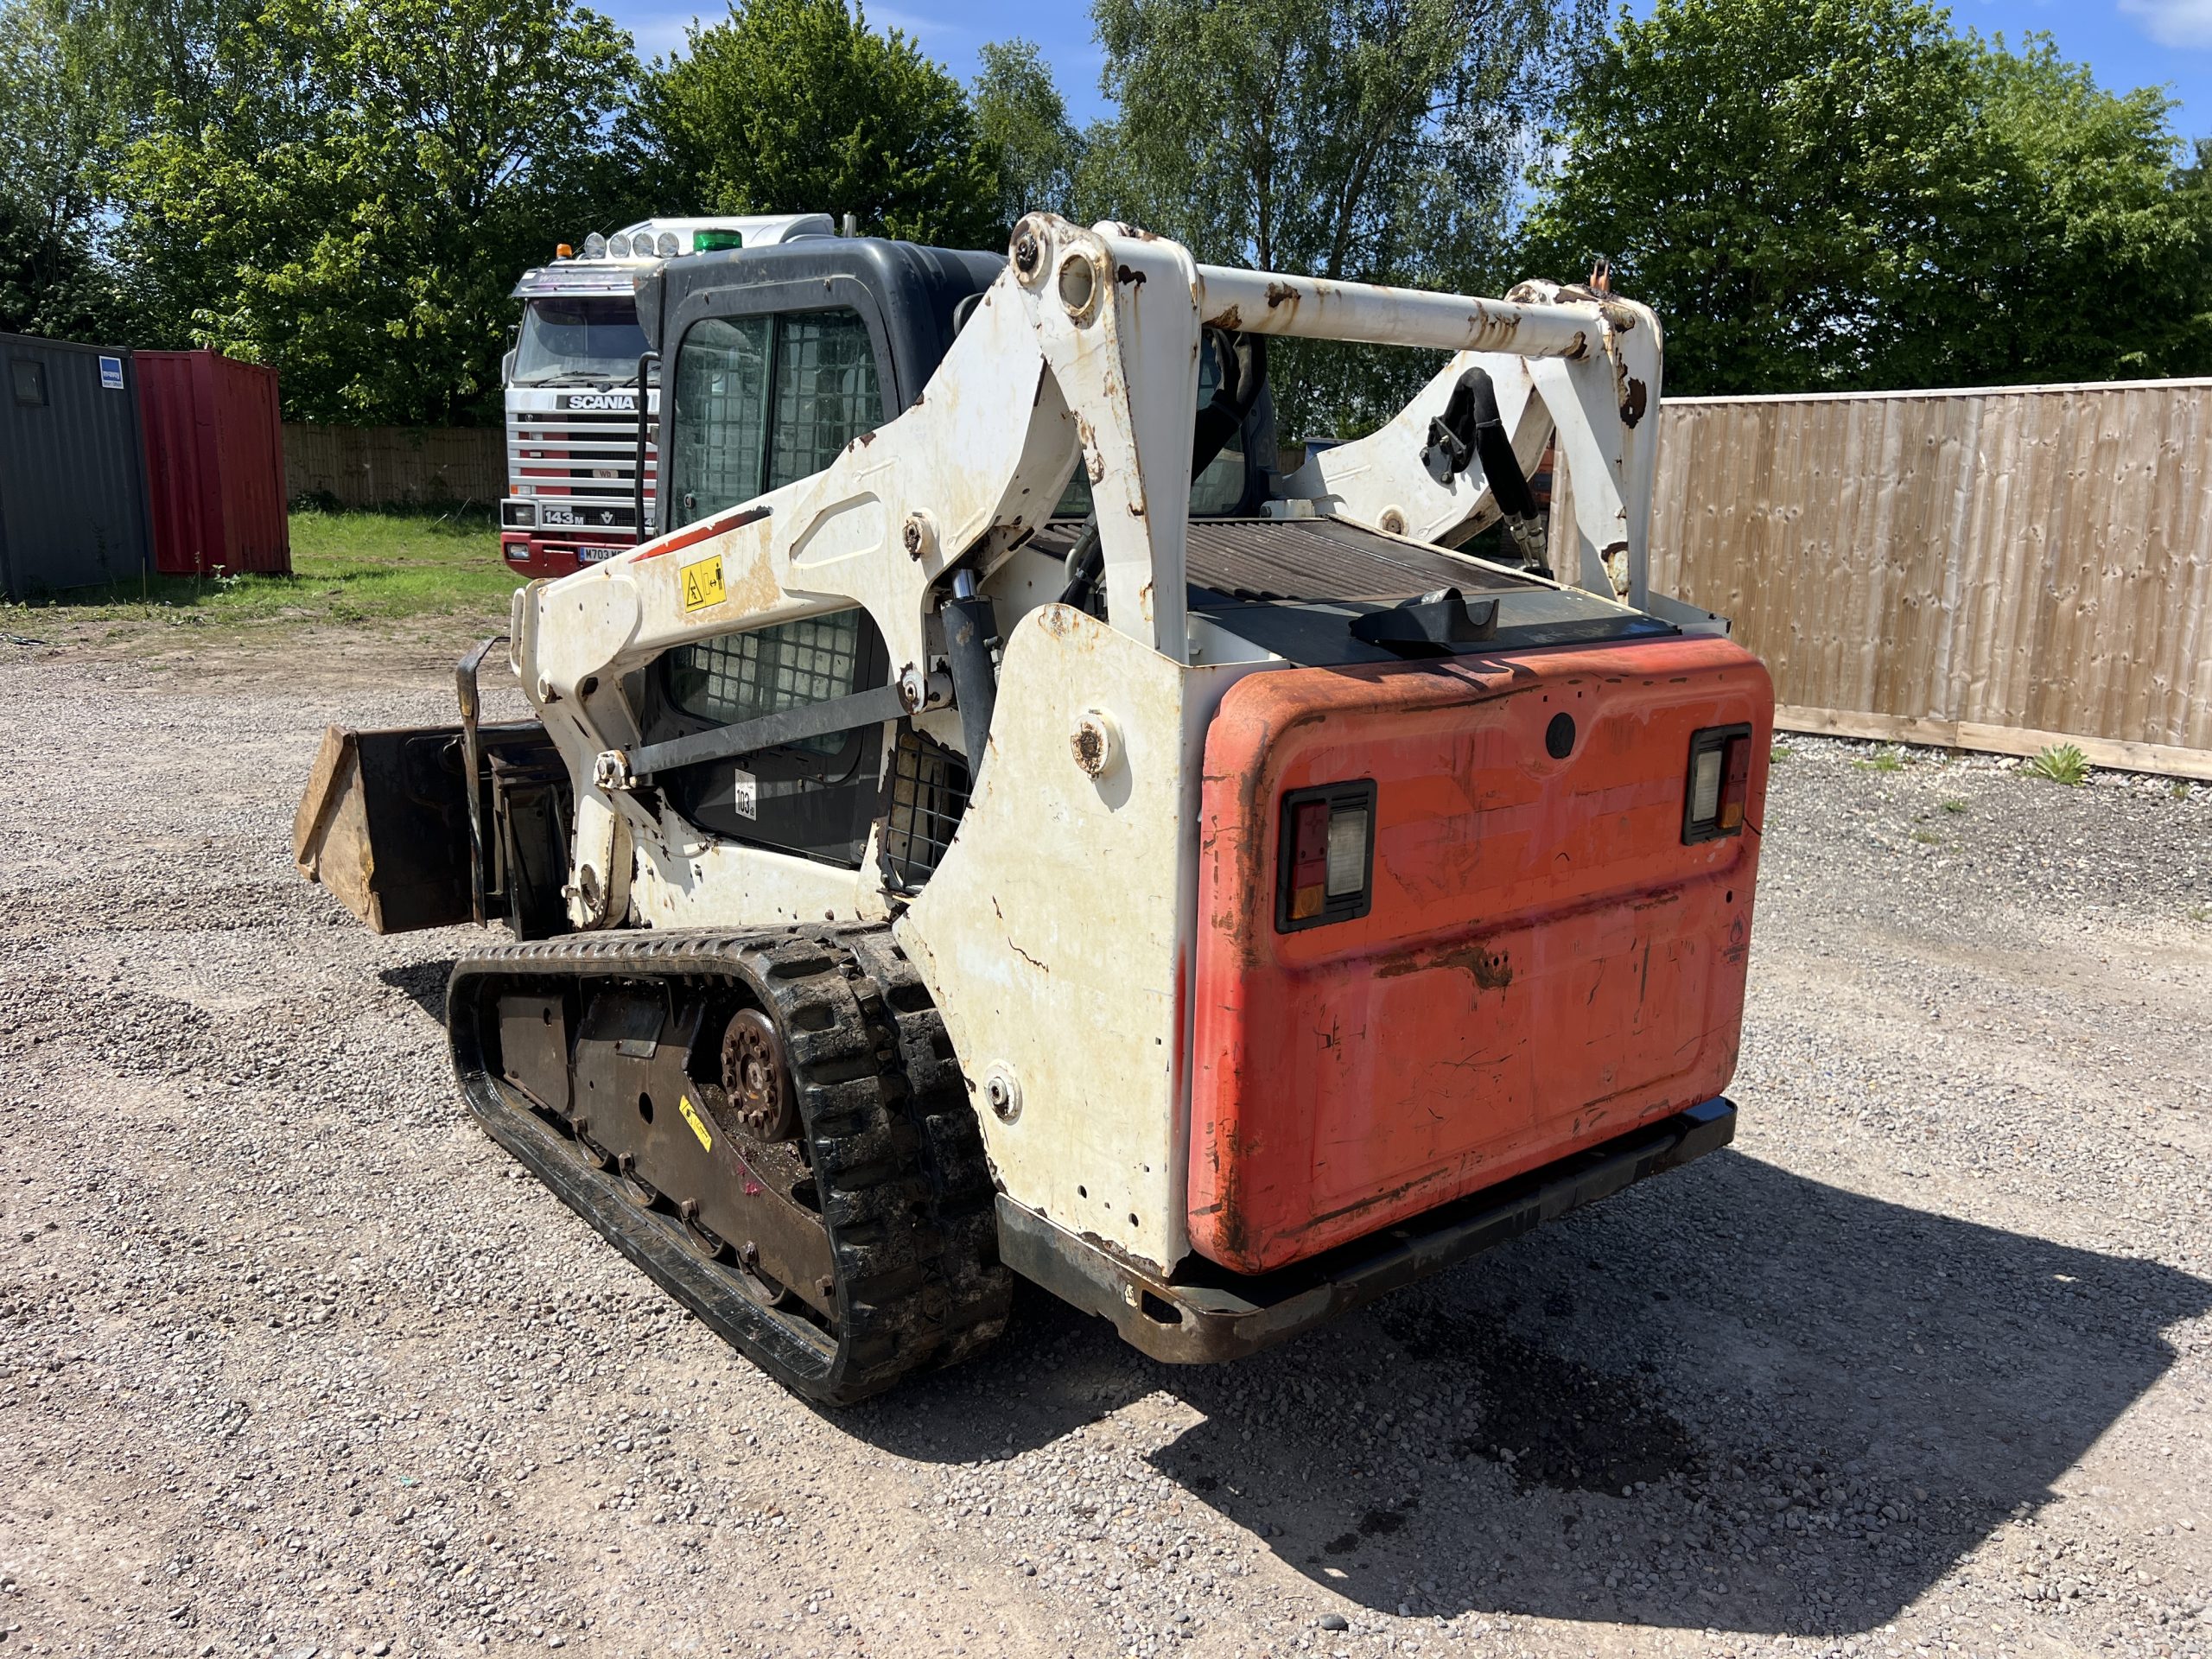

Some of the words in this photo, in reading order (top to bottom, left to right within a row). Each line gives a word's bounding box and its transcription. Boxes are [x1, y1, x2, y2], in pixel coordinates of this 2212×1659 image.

[569, 395, 635, 410] SCANIA
[585, 548, 609, 560] M703
[737, 790, 749, 813] 103
